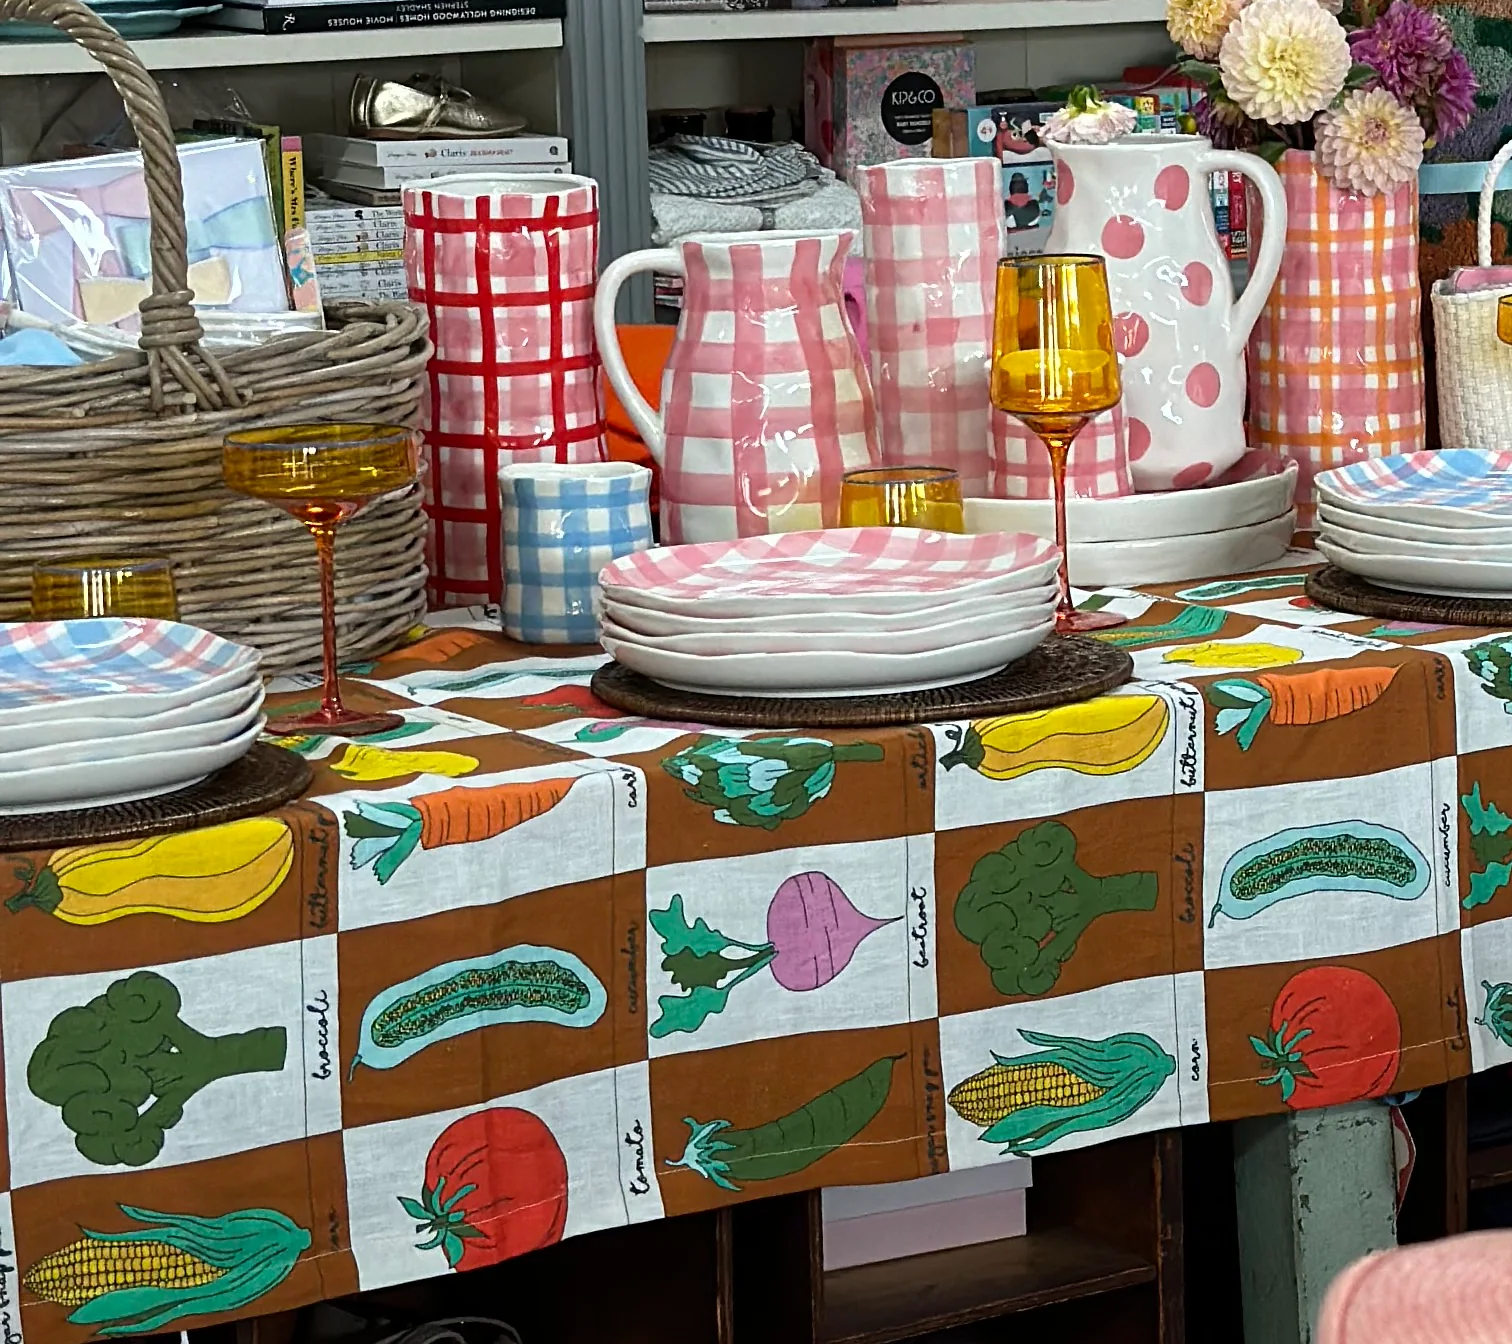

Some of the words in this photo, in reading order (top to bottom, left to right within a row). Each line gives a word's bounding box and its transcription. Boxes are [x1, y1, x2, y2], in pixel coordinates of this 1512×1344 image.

[327, 17, 363, 28] HOUSES
[365, 15, 394, 25] MOVIE
[399, 12, 431, 23] HOMES
[432, 10, 488, 22] HOLLYWOOD
[489, 7, 536, 19] DESIGNING
[1180, 696, 1199, 787] butternut
[1438, 802, 1451, 888] cucumber
[1174, 840, 1195, 924] broccoli
[306, 989, 332, 1081] broccoli
[1190, 1038, 1201, 1082] corn
[626, 1119, 651, 1195] tomato
